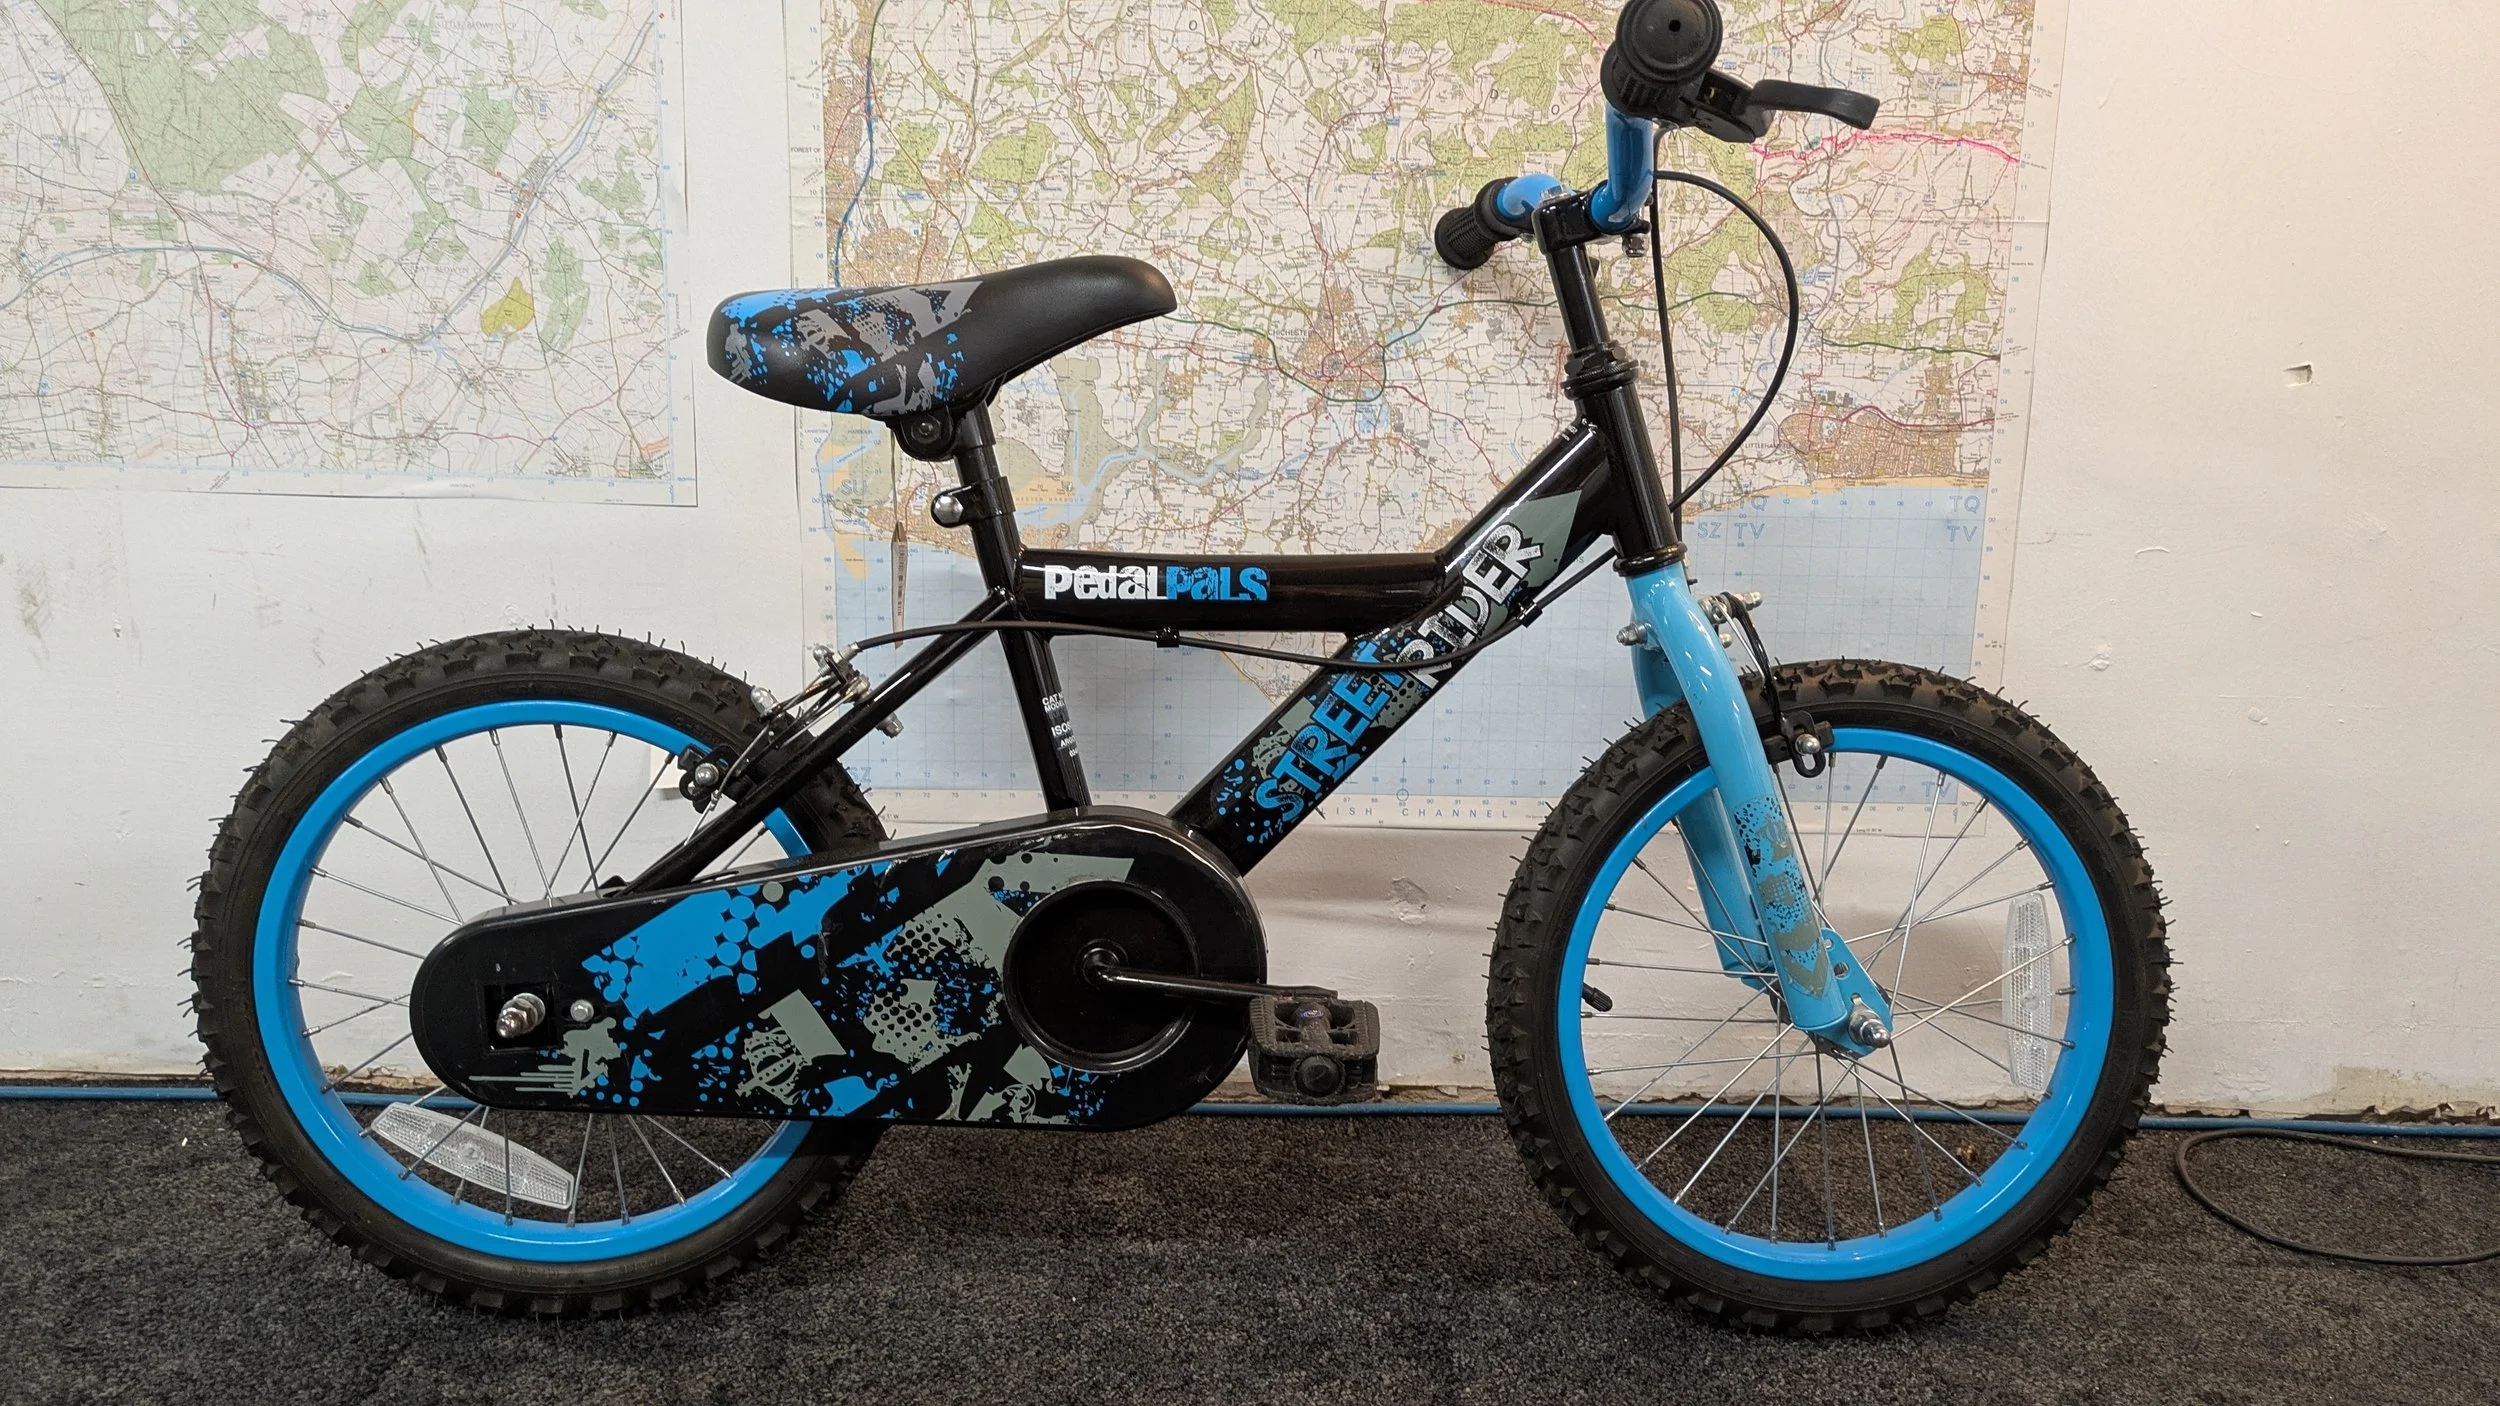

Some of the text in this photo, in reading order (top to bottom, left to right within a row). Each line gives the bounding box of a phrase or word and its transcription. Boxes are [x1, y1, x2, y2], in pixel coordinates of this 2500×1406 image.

[1950, 495, 1981, 514] TQ
[1697, 521, 1722, 539] SZ
[1733, 522, 1766, 540] TV
[1947, 525, 1978, 543] TV
[1255, 522, 1544, 824] STREET RIDER
[1042, 693, 1058, 706] CAT
[1921, 781, 1951, 798] TV
[1402, 807, 1508, 819] CHANNEL
